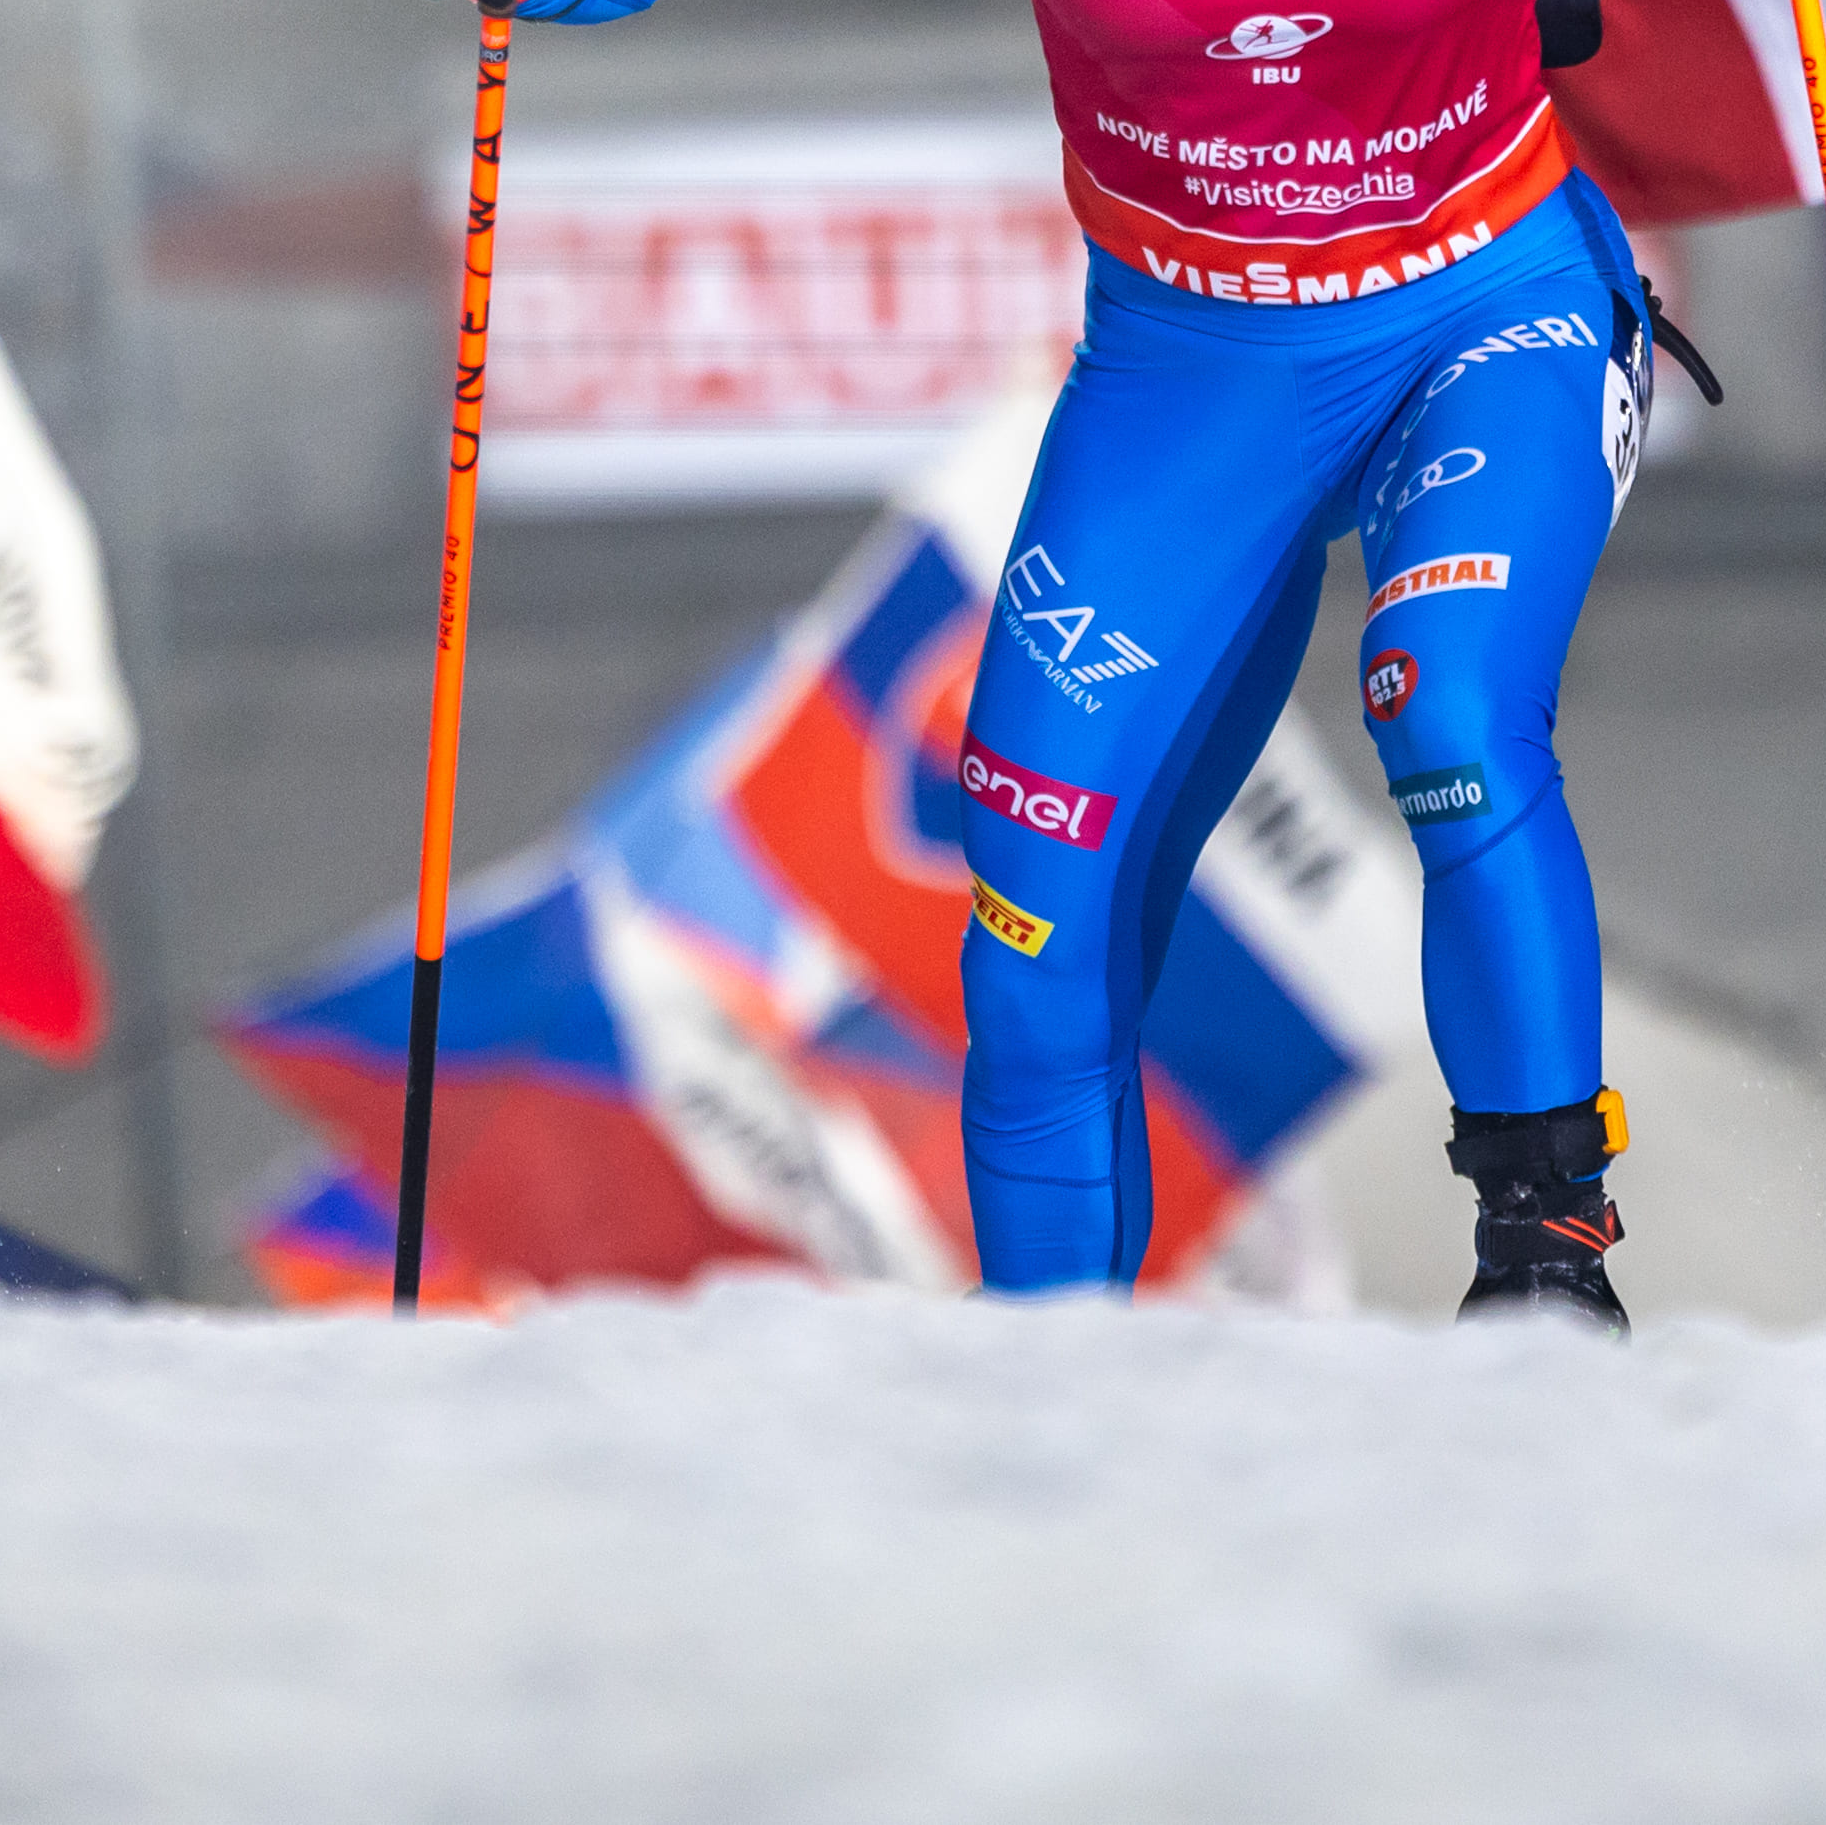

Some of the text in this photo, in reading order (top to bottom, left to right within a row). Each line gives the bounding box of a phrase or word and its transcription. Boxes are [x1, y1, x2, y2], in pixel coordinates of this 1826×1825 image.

[1252, 66, 1301, 85] IBU
[1801, 56, 1818, 88] 40
[1096, 78, 1489, 171] NOVÉ MĚSTO NA MORAVĚ
[1184, 168, 1416, 212] #VisitCzechia
[438, 534, 460, 650] PREMIO 40
[1005, 544, 1160, 684] EA7
[1368, 662, 1405, 695] RTL
[1371, 681, 1406, 709] 102.5
[963, 754, 1091, 840] enel
[1396, 778, 1483, 816] ernardo
